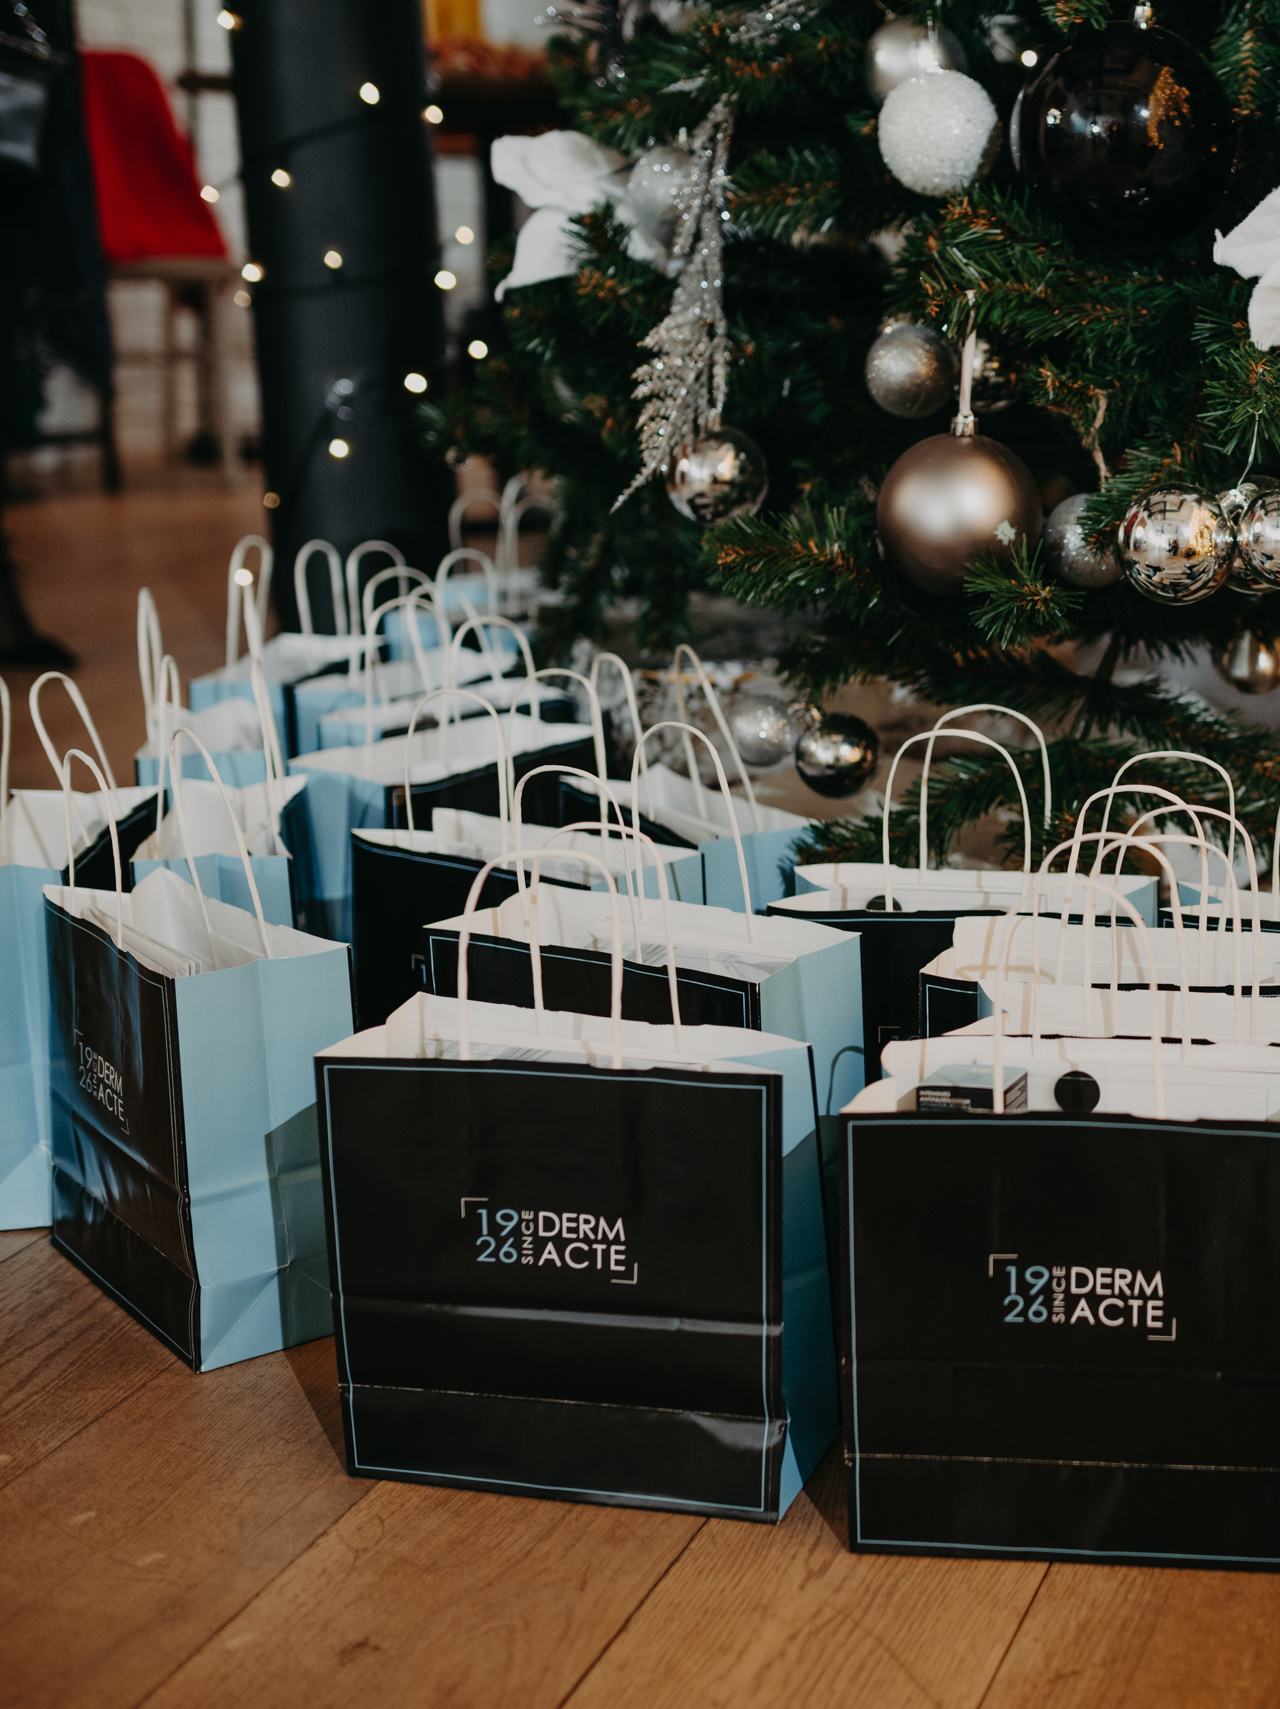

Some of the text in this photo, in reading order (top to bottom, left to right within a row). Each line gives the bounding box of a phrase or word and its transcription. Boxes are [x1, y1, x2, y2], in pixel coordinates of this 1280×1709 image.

[79, 1041, 93, 1069] 19
[79, 1065, 93, 1093] 26
[97, 1055, 123, 1097] DERM
[97, 1083, 125, 1122] ACTE
[476, 1208, 520, 1237] 19
[521, 1210, 535, 1265] SINCE
[538, 1211, 626, 1242] DERM
[475, 1235, 519, 1264] 26
[537, 1241, 627, 1272] ACTE
[1005, 1265, 1050, 1296] 19
[1051, 1265, 1067, 1324] SINCE
[1070, 1266, 1164, 1298] DERM
[1003, 1294, 1048, 1324] 26
[1069, 1297, 1165, 1329] ACTE
